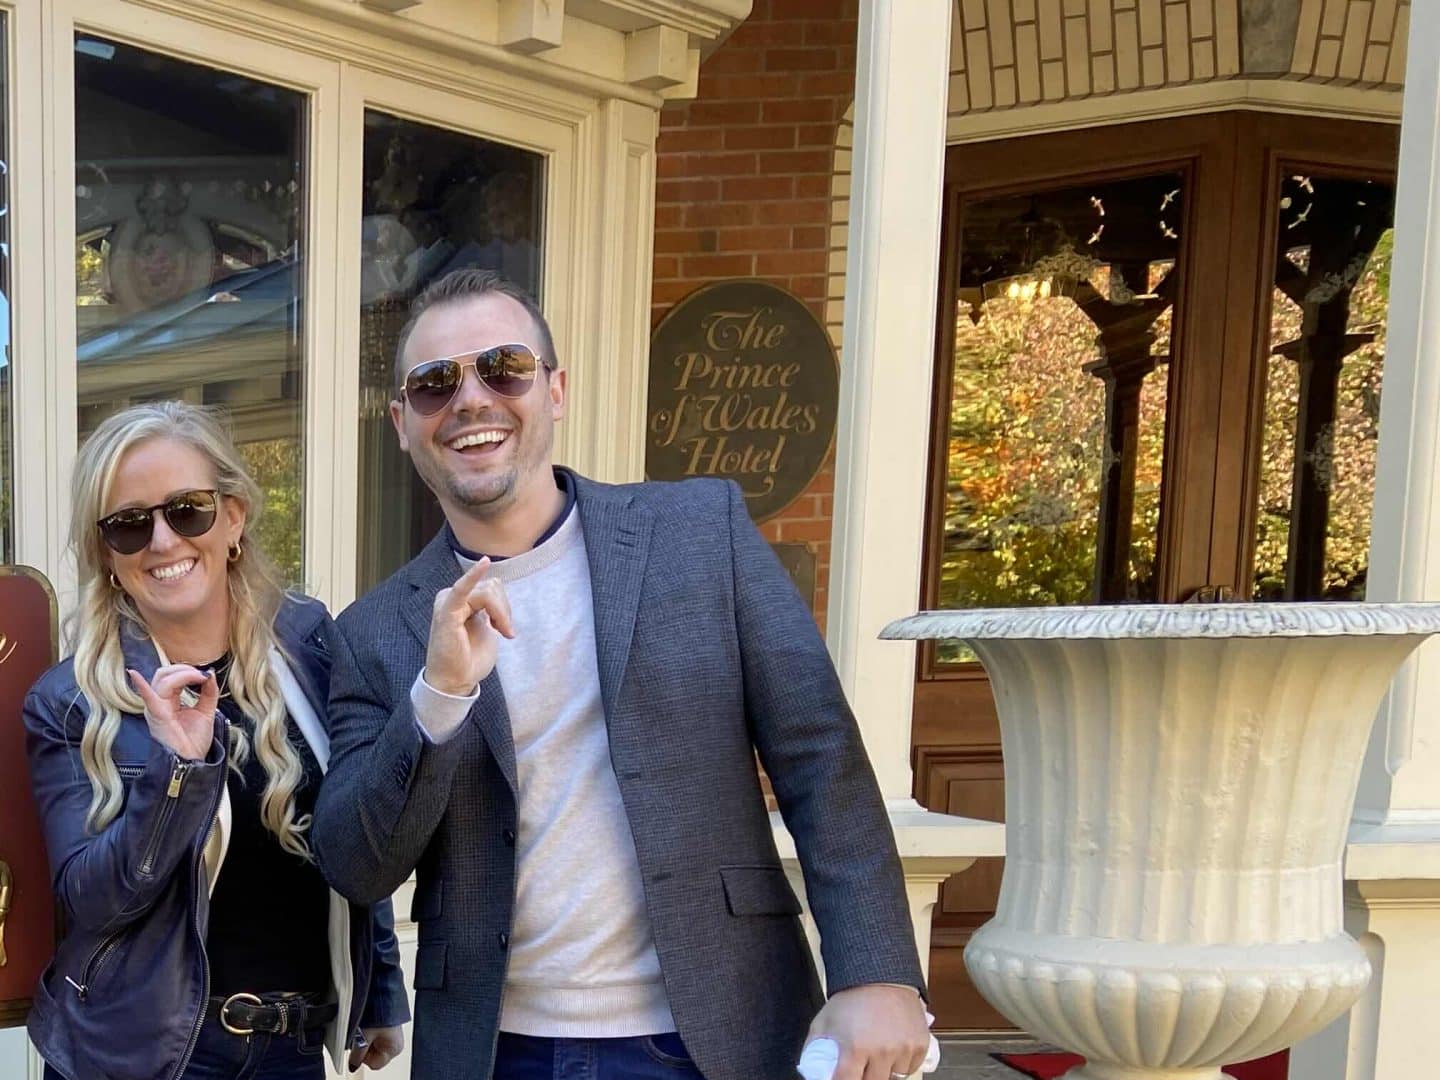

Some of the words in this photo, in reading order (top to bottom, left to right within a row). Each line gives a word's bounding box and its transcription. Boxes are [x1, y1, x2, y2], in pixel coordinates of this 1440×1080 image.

[701, 307, 788, 351] The
[673, 352, 801, 391] Prince
[651, 393, 692, 447] of
[697, 391, 821, 434] Wales
[680, 434, 787, 478] Hotel
